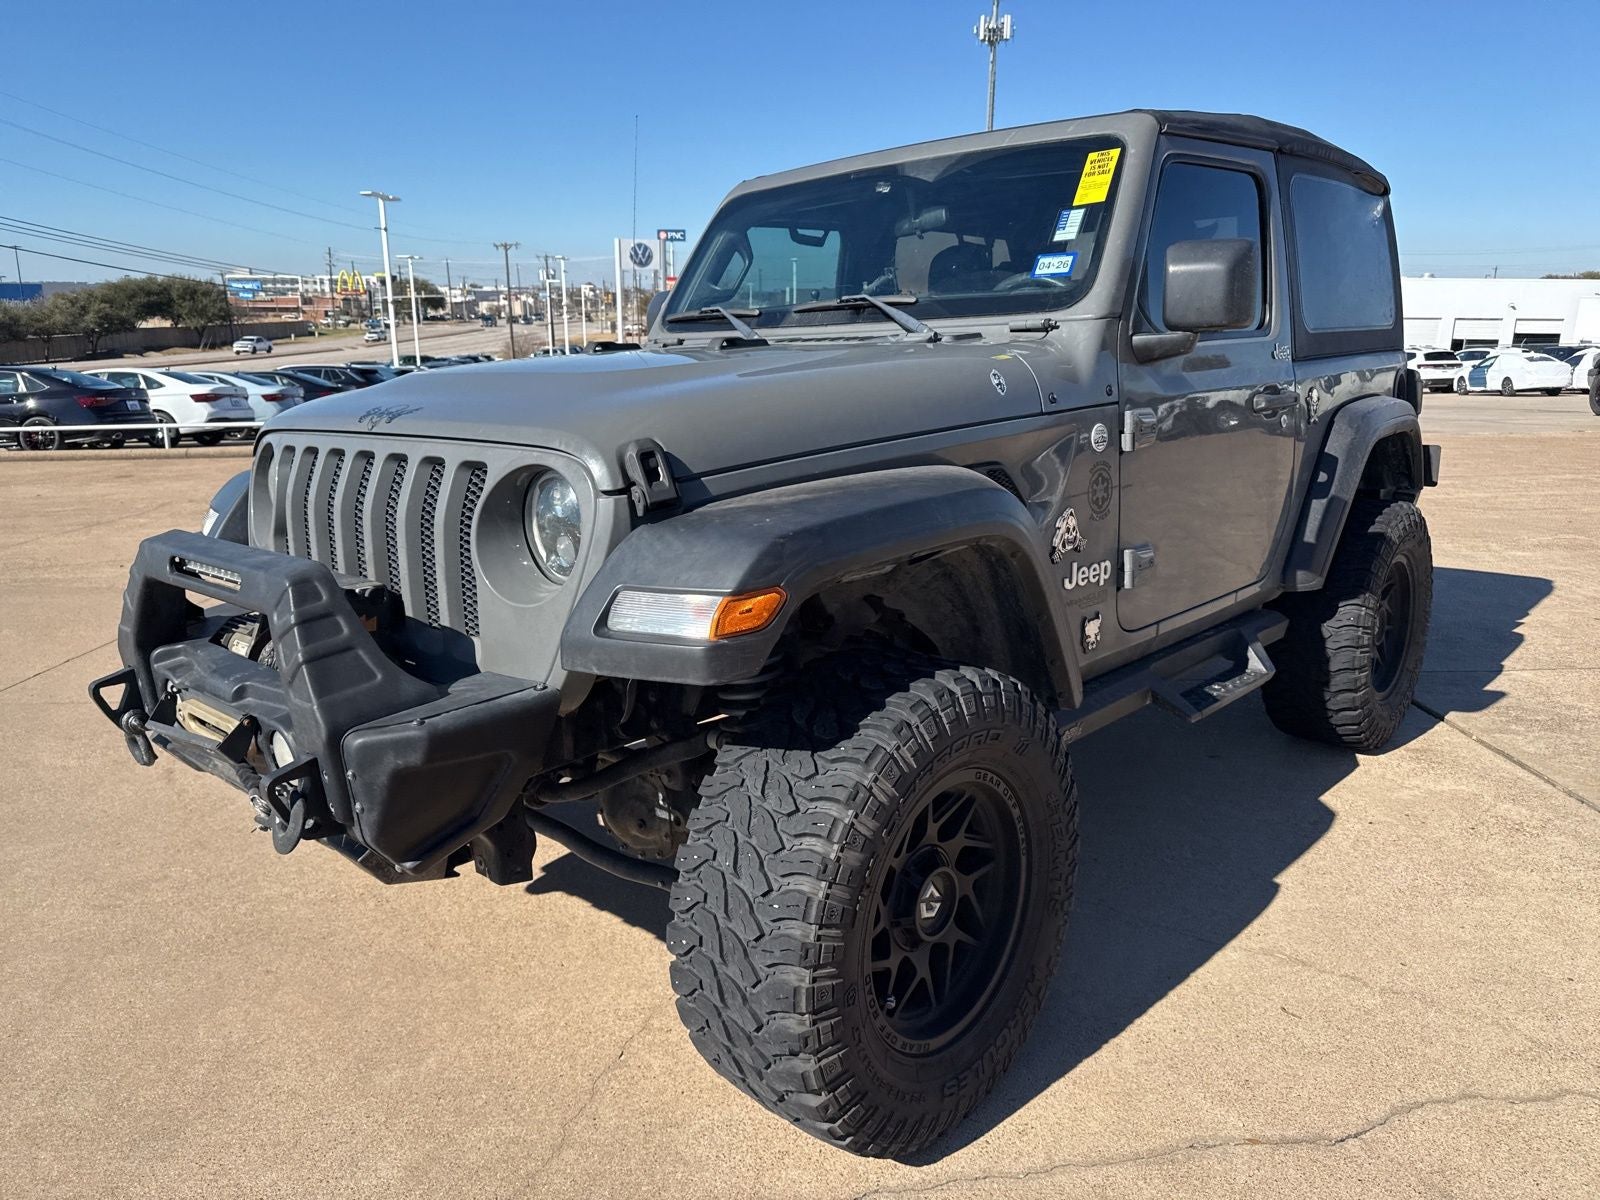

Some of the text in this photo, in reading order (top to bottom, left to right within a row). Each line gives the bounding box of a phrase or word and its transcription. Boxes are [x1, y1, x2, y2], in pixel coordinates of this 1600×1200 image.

[1090, 156, 1114, 165] VEHICLE
[1097, 168, 1111, 176] SALE
[668, 231, 684, 239] PNC
[1063, 560, 1112, 590] Jeep
[975, 771, 1027, 858] GEAR OFF ROAD
[864, 972, 931, 1053] GEAR OFF ROAD
